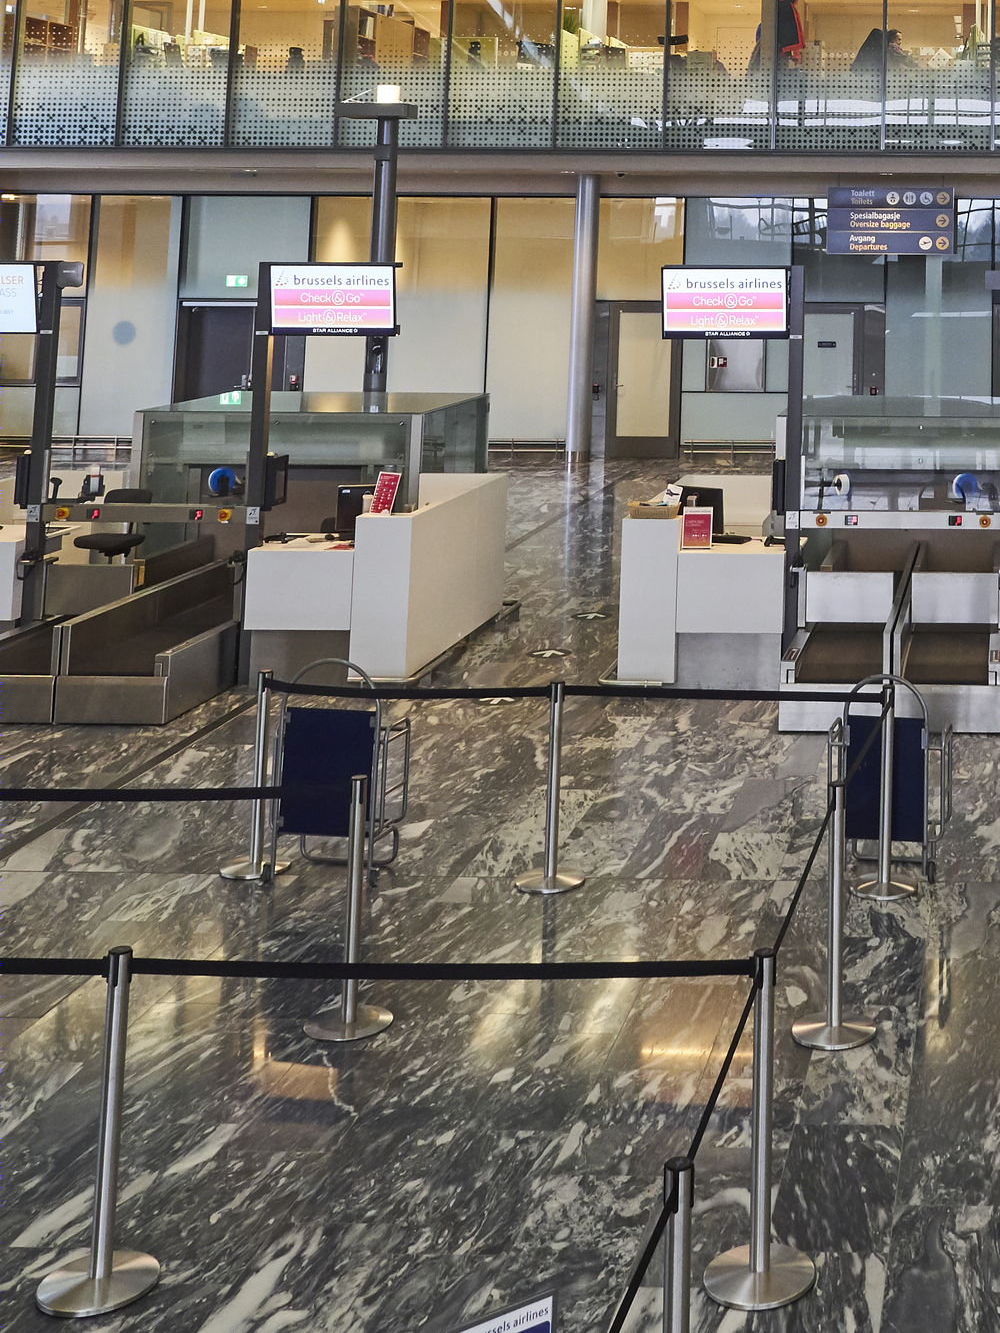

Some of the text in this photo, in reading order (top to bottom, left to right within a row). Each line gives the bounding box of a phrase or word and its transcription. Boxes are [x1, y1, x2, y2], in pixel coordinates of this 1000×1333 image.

[850, 189, 875, 197] Toalett
[849, 211, 901, 221] Spesialbagasje
[849, 220, 911, 230] Oversize baggage
[849, 234, 876, 243] Avgang
[849, 243, 888, 251] Departures
[0, 275, 24, 285] LSER
[293, 274, 390, 286] brussels airlines
[686, 278, 782, 289] brussels airlines
[0, 287, 17, 298] ASS
[513, 1306, 549, 1328] airlines
